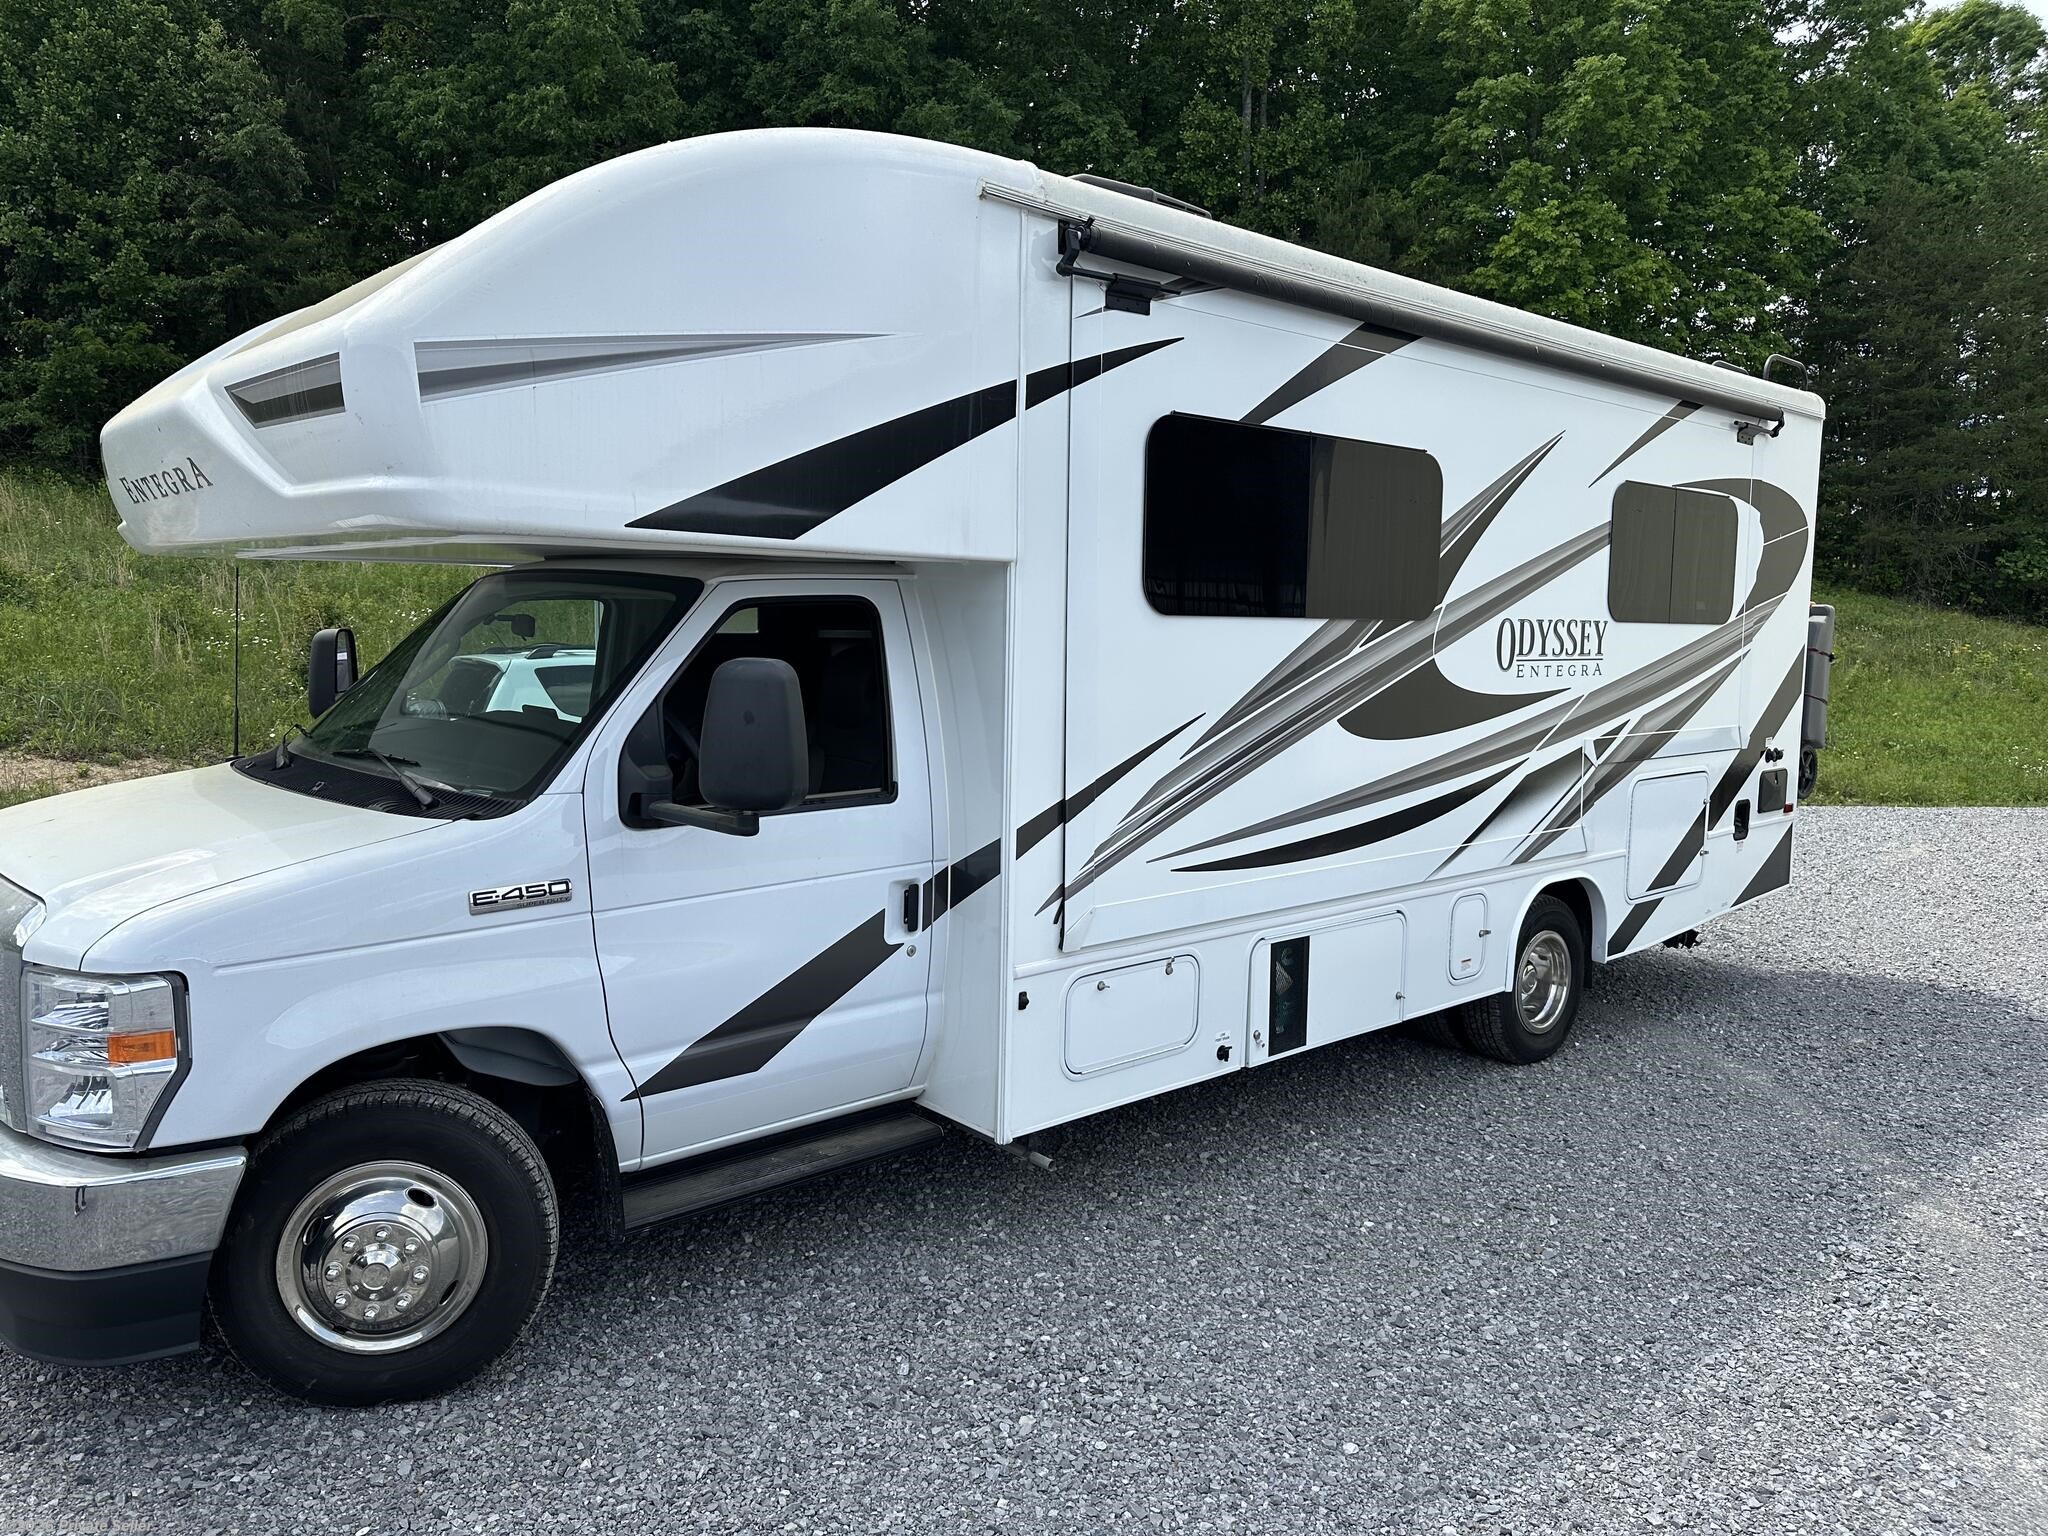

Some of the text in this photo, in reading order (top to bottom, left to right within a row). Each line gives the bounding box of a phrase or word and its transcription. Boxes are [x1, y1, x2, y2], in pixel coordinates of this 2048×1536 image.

[119, 457, 213, 504] ENTEGRA
[1496, 617, 1608, 672] ODYSSEY
[1516, 663, 1602, 678] ENTEGRA
[472, 880, 570, 906] E-450
